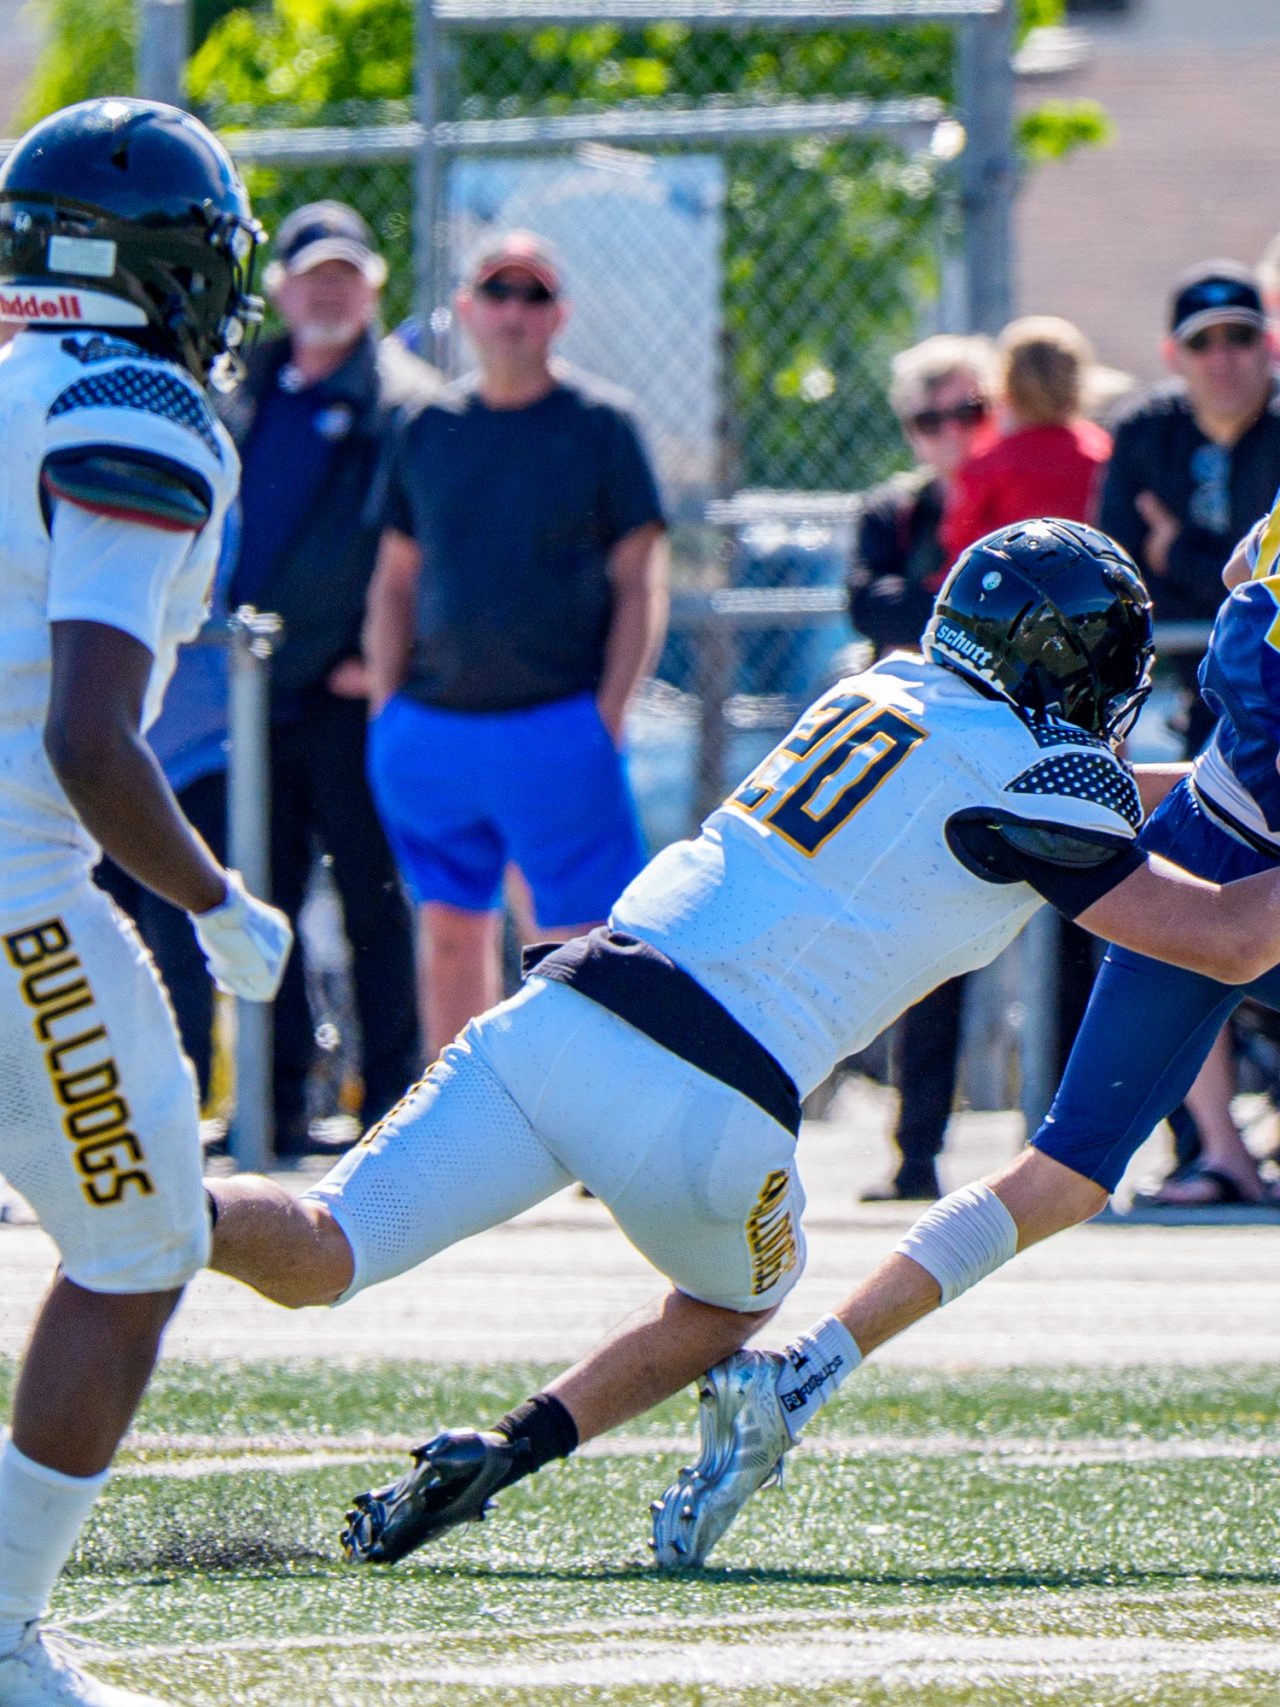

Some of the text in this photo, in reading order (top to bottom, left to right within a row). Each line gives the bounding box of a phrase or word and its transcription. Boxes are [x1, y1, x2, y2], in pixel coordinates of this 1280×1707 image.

[0, 293, 82, 319] iddell
[725, 691, 931, 858] 20
[2, 916, 155, 1207] BULLDOGS
